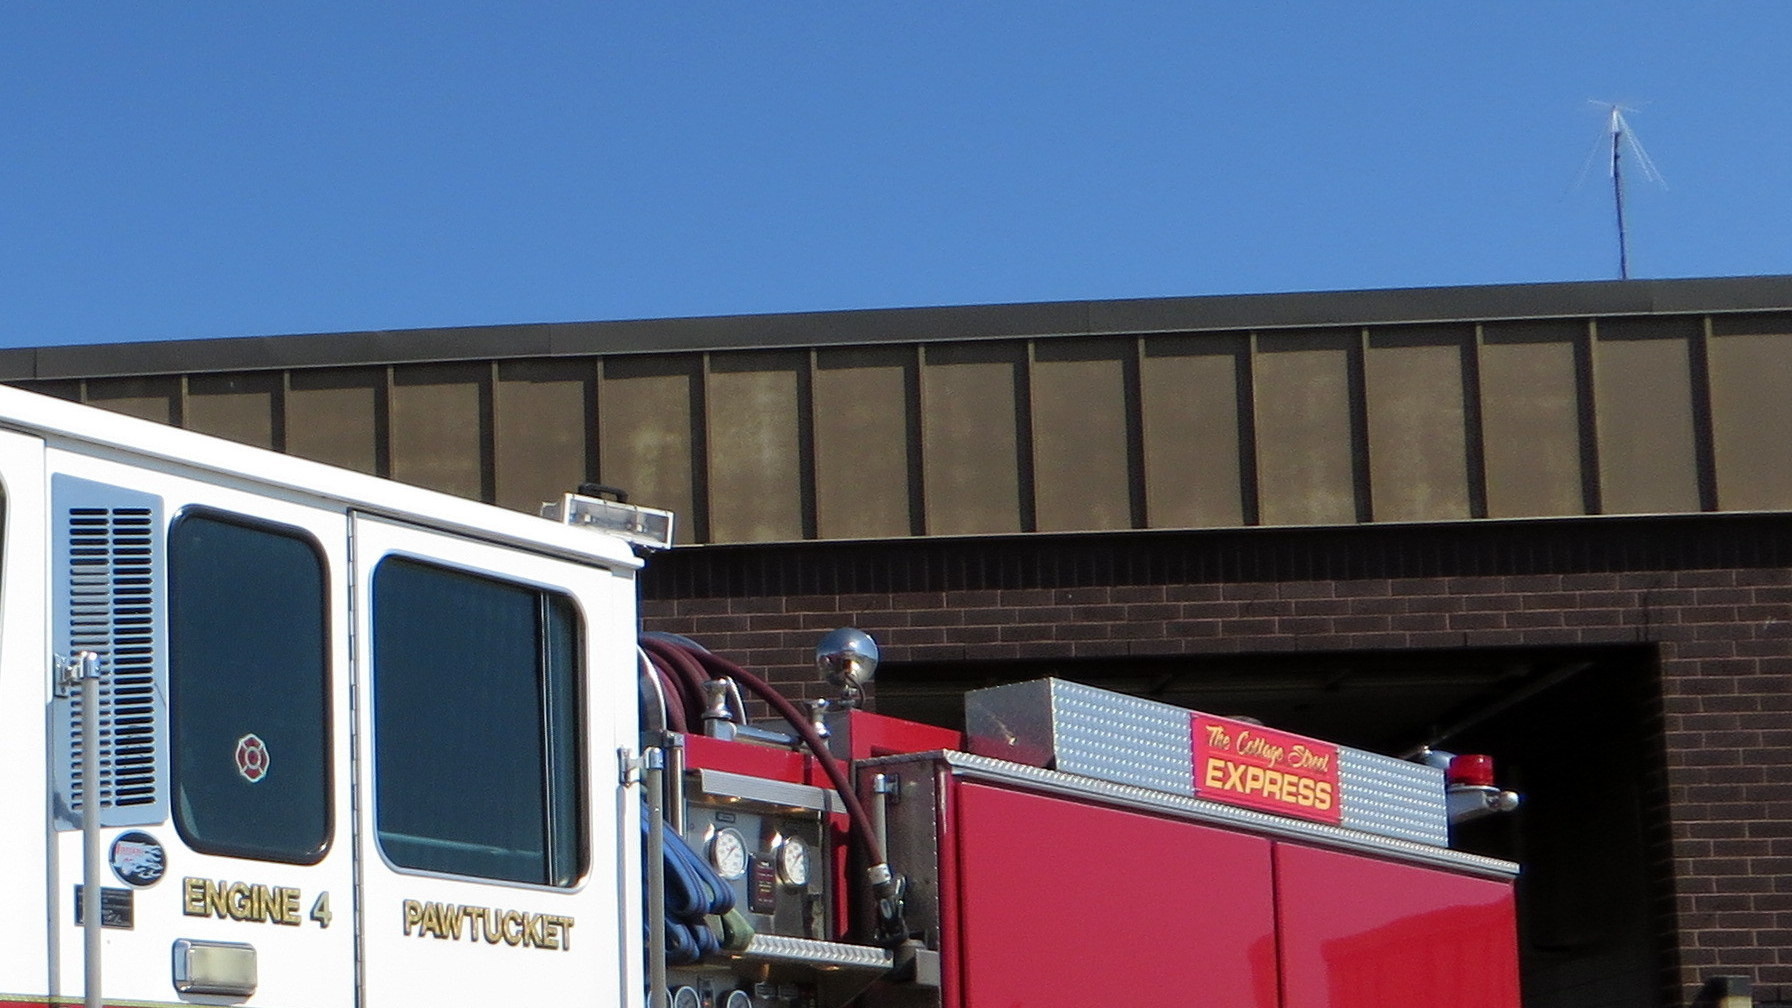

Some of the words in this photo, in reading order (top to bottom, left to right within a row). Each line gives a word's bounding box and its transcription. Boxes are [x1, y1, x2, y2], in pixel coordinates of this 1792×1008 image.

[1206, 725, 1232, 750] The
[1205, 758, 1333, 810] EXPRESS
[182, 877, 302, 927] ENGINE
[310, 891, 333, 927] 4
[402, 899, 576, 951] PAWTUCKET
